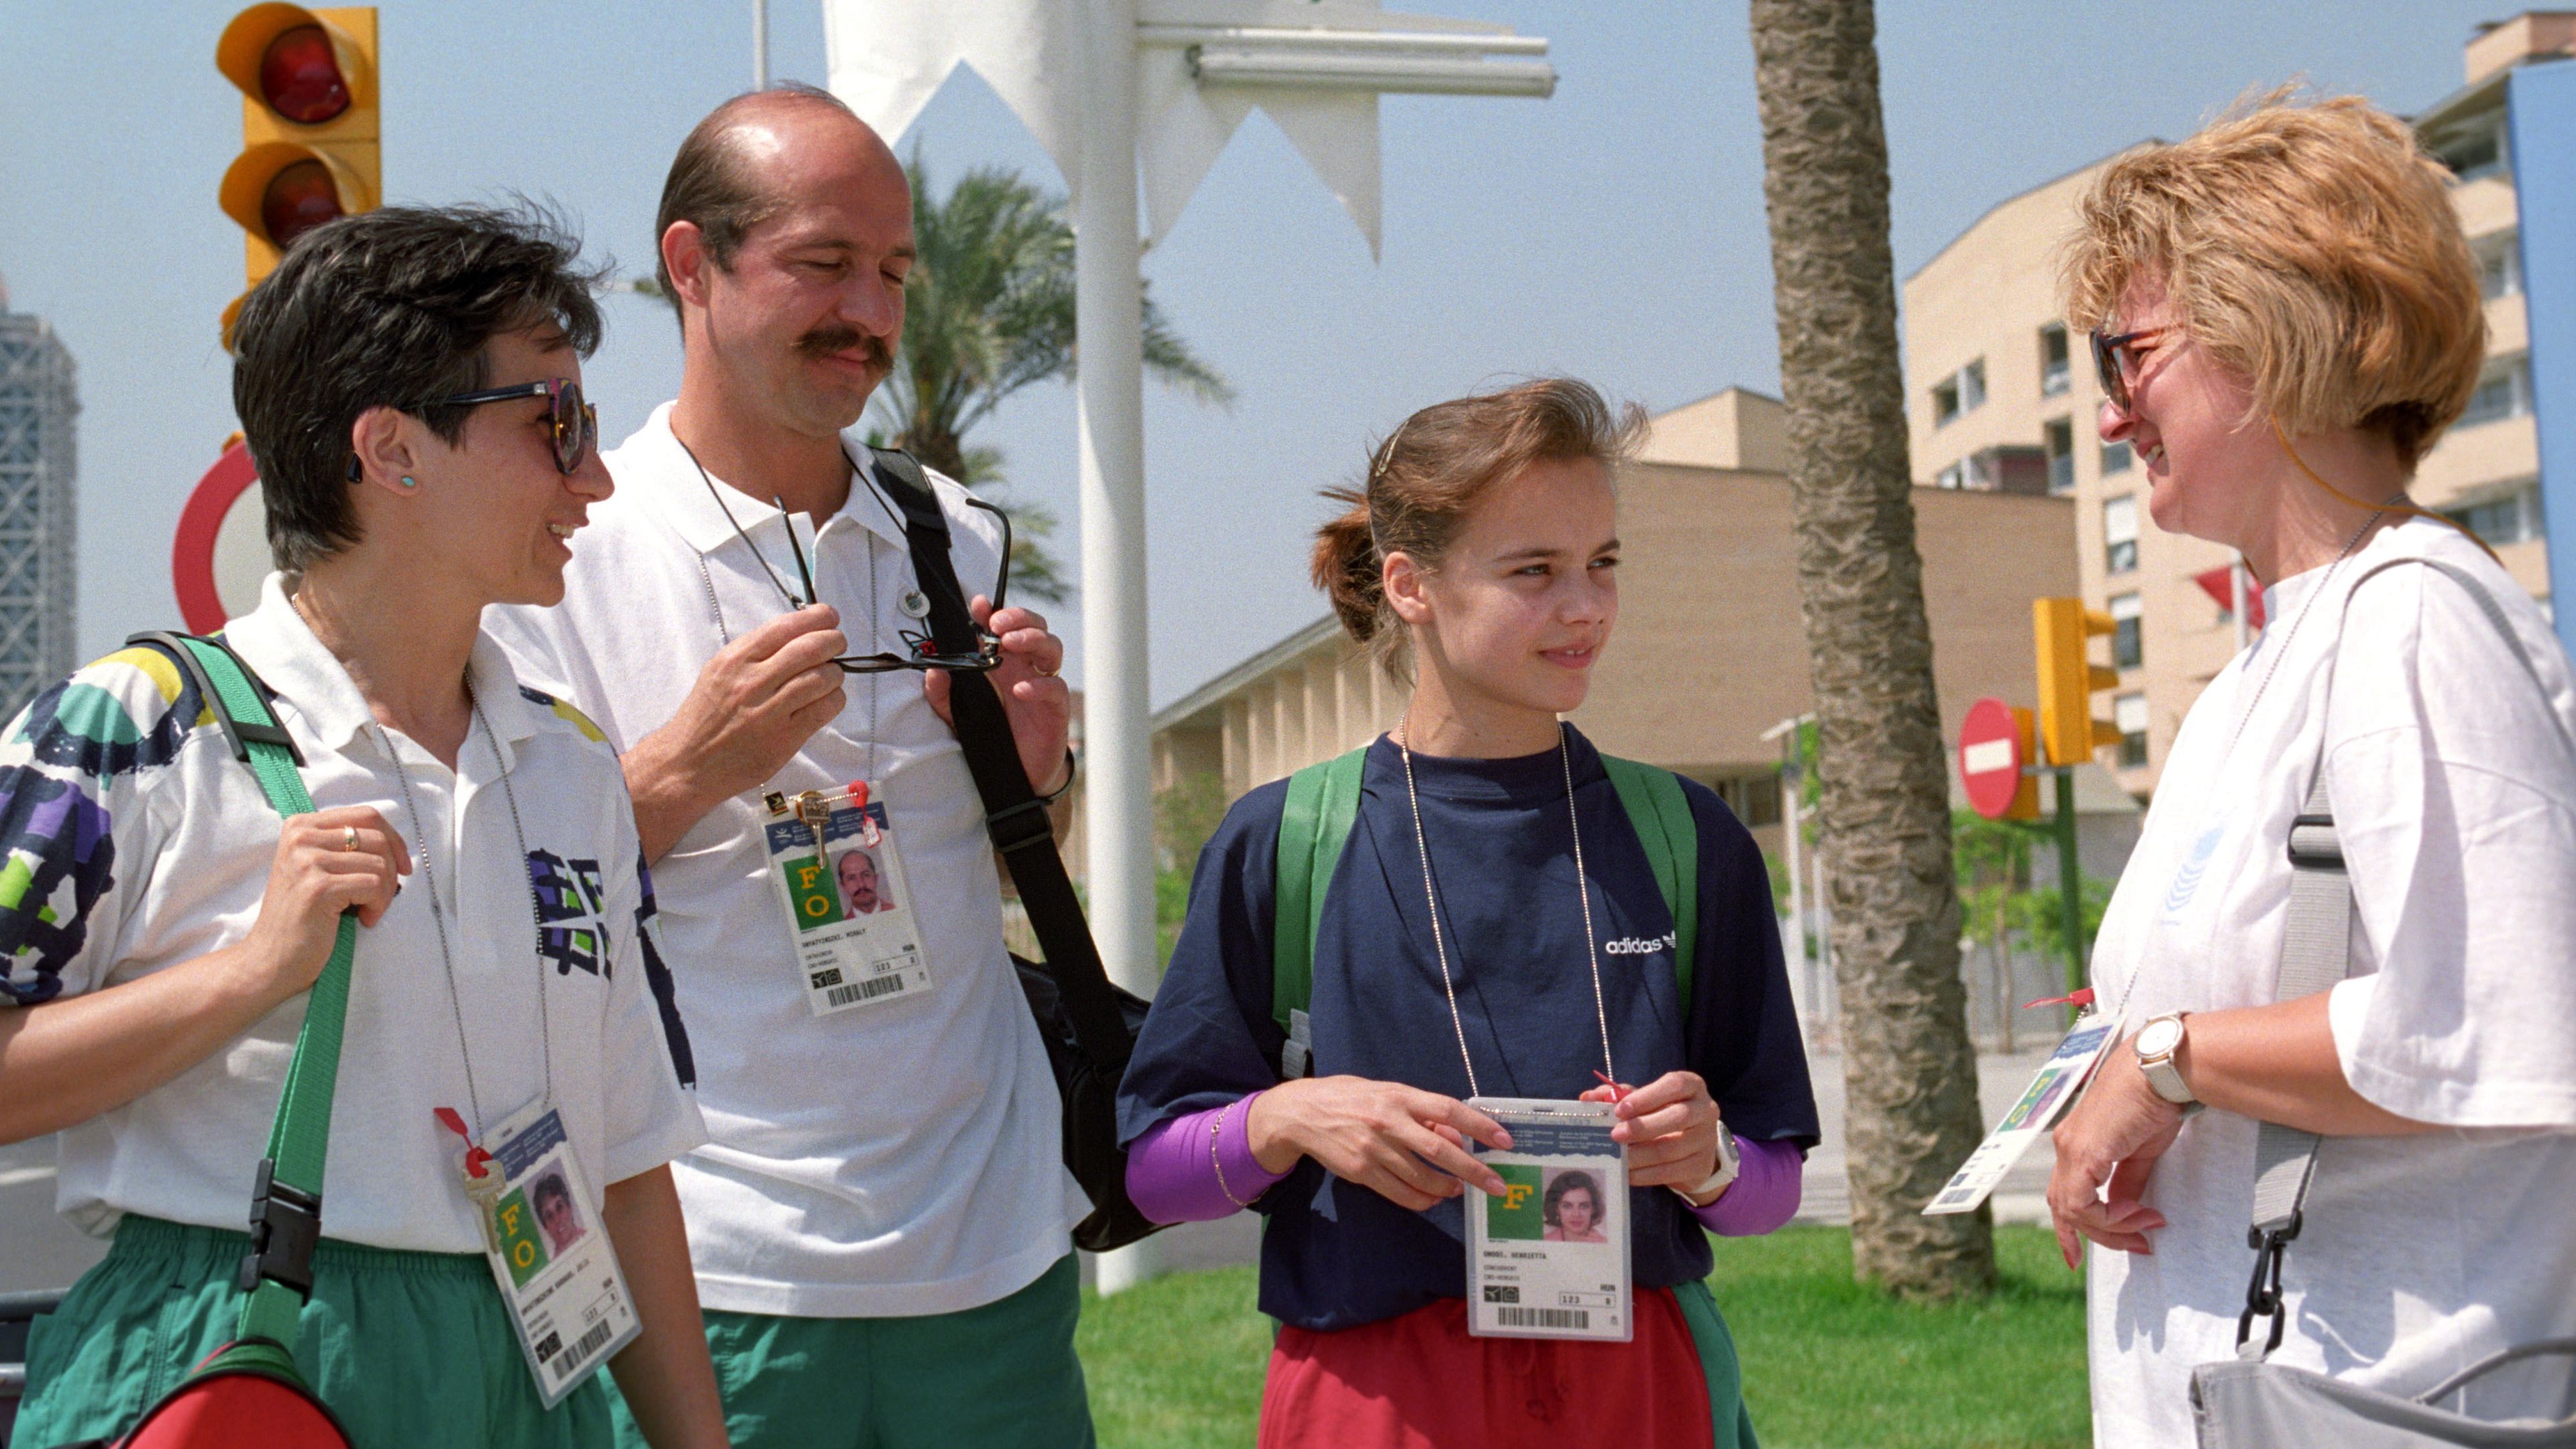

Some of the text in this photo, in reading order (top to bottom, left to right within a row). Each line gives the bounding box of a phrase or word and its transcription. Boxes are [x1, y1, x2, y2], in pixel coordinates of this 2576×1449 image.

[797, 866, 820, 890] F
[805, 895, 829, 916] O
[1605, 937, 1663, 954] adidas
[1503, 1184, 1534, 1210] F
[500, 1203, 519, 1238] F
[515, 1239, 535, 1268] O
[1600, 1283, 1615, 1291] HUN
[1562, 1295, 1579, 1304] 123
